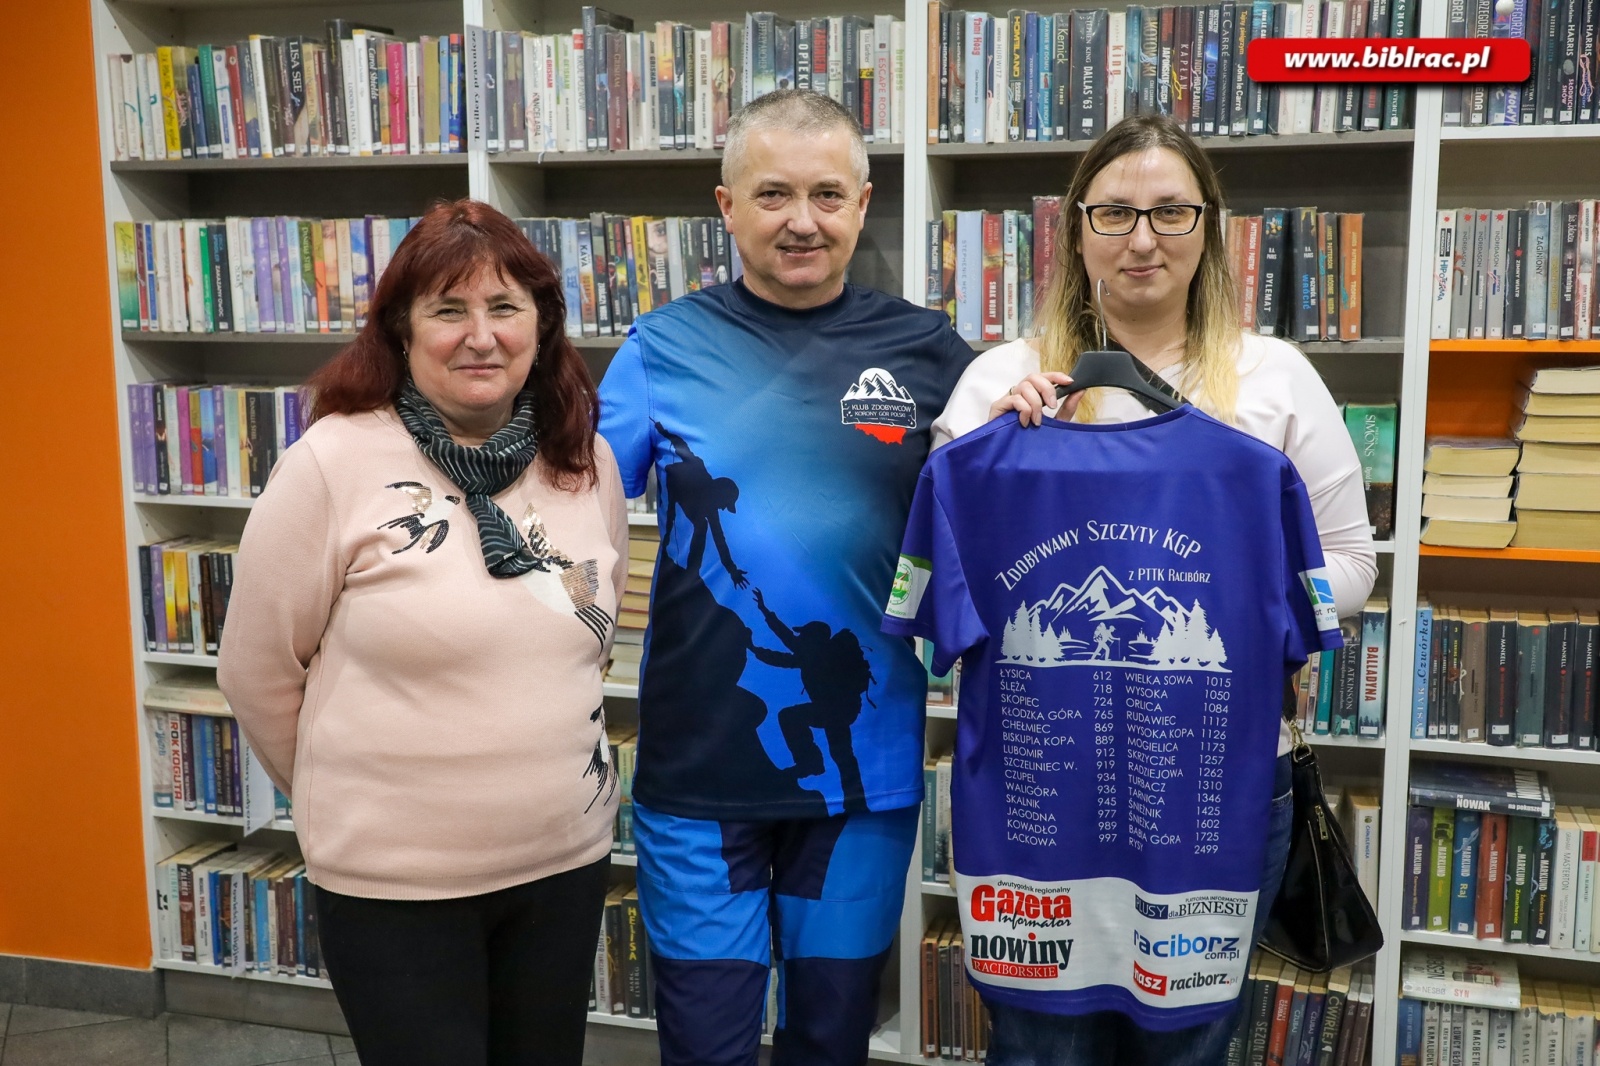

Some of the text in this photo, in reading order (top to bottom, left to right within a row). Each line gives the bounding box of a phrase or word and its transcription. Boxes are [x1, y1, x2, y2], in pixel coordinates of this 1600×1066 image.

[971, 17, 983, 56] Tami Hoag
[1085, 15, 1093, 44] STEPHEN
[1238, 10, 1248, 55] Tajny pielgrzym
[1013, 16, 1021, 77] HOMELAND
[1056, 28, 1068, 64] Kernick
[1566, 25, 1575, 56] HARRIS
[1084, 46, 1092, 63] KING
[288, 41, 302, 93] LISA SEE
[368, 47, 379, 100] Carol Shields
[1236, 64, 1245, 82] John
[1083, 66, 1093, 95] DALLAS
[878, 57, 886, 127] ESCAPE ROOM
[1234, 90, 1244, 112] Carré
[579, 244, 588, 268] KAVA
[1535, 236, 1544, 276] ZAGINIONY
[1263, 273, 1274, 312] DYLEMAT
[1302, 274, 1312, 310] WRÓCIĆ
[871, 403, 912, 412] ZDOBYWCÓW
[1364, 414, 1376, 457] SIMONS
[1138, 568, 1165, 582] PTTK
[1560, 641, 1568, 668] MANKELL
[1000, 669, 1112, 680] ŁYSICA 612
[1125, 672, 1231, 688] WIELKA SOWA 1015
[1364, 646, 1379, 702] BALLADYNA
[1000, 681, 1112, 694] ŚLĘŻA 718
[1126, 686, 1230, 701] WYSOKA 1050
[1346, 666, 1356, 710] ATKINSON
[1001, 694, 1112, 708] SKOPIEC 724
[1126, 698, 1228, 714] ORLICA 1084
[1002, 707, 1113, 720] KŁODZKA GÓRA 765
[1126, 711, 1228, 727] RUDAWIEC 1112
[1002, 718, 1114, 734] CHEŁMIEC 869
[1127, 724, 1226, 740] WYSOKA KOPA 1126
[1003, 732, 1114, 746] BISKUPIA KOPA 889
[1128, 737, 1225, 752] MOGIELICA 1173
[1003, 745, 1114, 758] LUBOMIR 912
[1128, 749, 1224, 766] SKRZYCZNE 1257
[170, 721, 183, 800] ROK KOGUTA
[1096, 760, 1115, 769] 919
[1005, 770, 1116, 783] CZUPEL 934
[1128, 762, 1223, 779] RADZIEJOWA 1262
[1006, 782, 1116, 796] WALIGÓRA 936
[1128, 774, 1222, 792] TURBACZ 1310
[1006, 794, 1116, 808] SKALNIK 945
[1128, 787, 1221, 805] TARNICA 1346
[1197, 806, 1220, 816] 1425
[1456, 799, 1491, 811] NOWAK
[1007, 807, 1116, 822] JAGODNA 977
[1008, 819, 1116, 834] KOWADŁO 989
[1197, 819, 1220, 828] 1602
[1008, 832, 1117, 846] LACKOWA 997
[1150, 834, 1180, 845] GÓRA
[1196, 832, 1219, 841] 1725
[1194, 844, 1218, 854] 2499
[1413, 843, 1423, 875] MARKLUND
[1489, 851, 1499, 882] MARKLUND
[1516, 852, 1527, 886] MARKLUND
[1561, 852, 1571, 891] MASTERTON
[997, 880, 1071, 895] dwutygodnik regionalny
[1458, 883, 1469, 898] Raj
[970, 884, 1072, 922] Gazeta
[1168, 909, 1179, 918] dla
[1179, 902, 1248, 917] BIZNESU
[998, 909, 1072, 930] Informator
[627, 907, 637, 961] HELISA
[970, 932, 1073, 970] nowiny
[1133, 928, 1240, 958] raciborz
[1204, 949, 1240, 961] com.pl
[974, 961, 1057, 978] RACIBORSKIE
[1133, 967, 1163, 991] nasz
[1453, 989, 1470, 998] SYN
[1322, 995, 1342, 1048] ĆWIRLEJ
